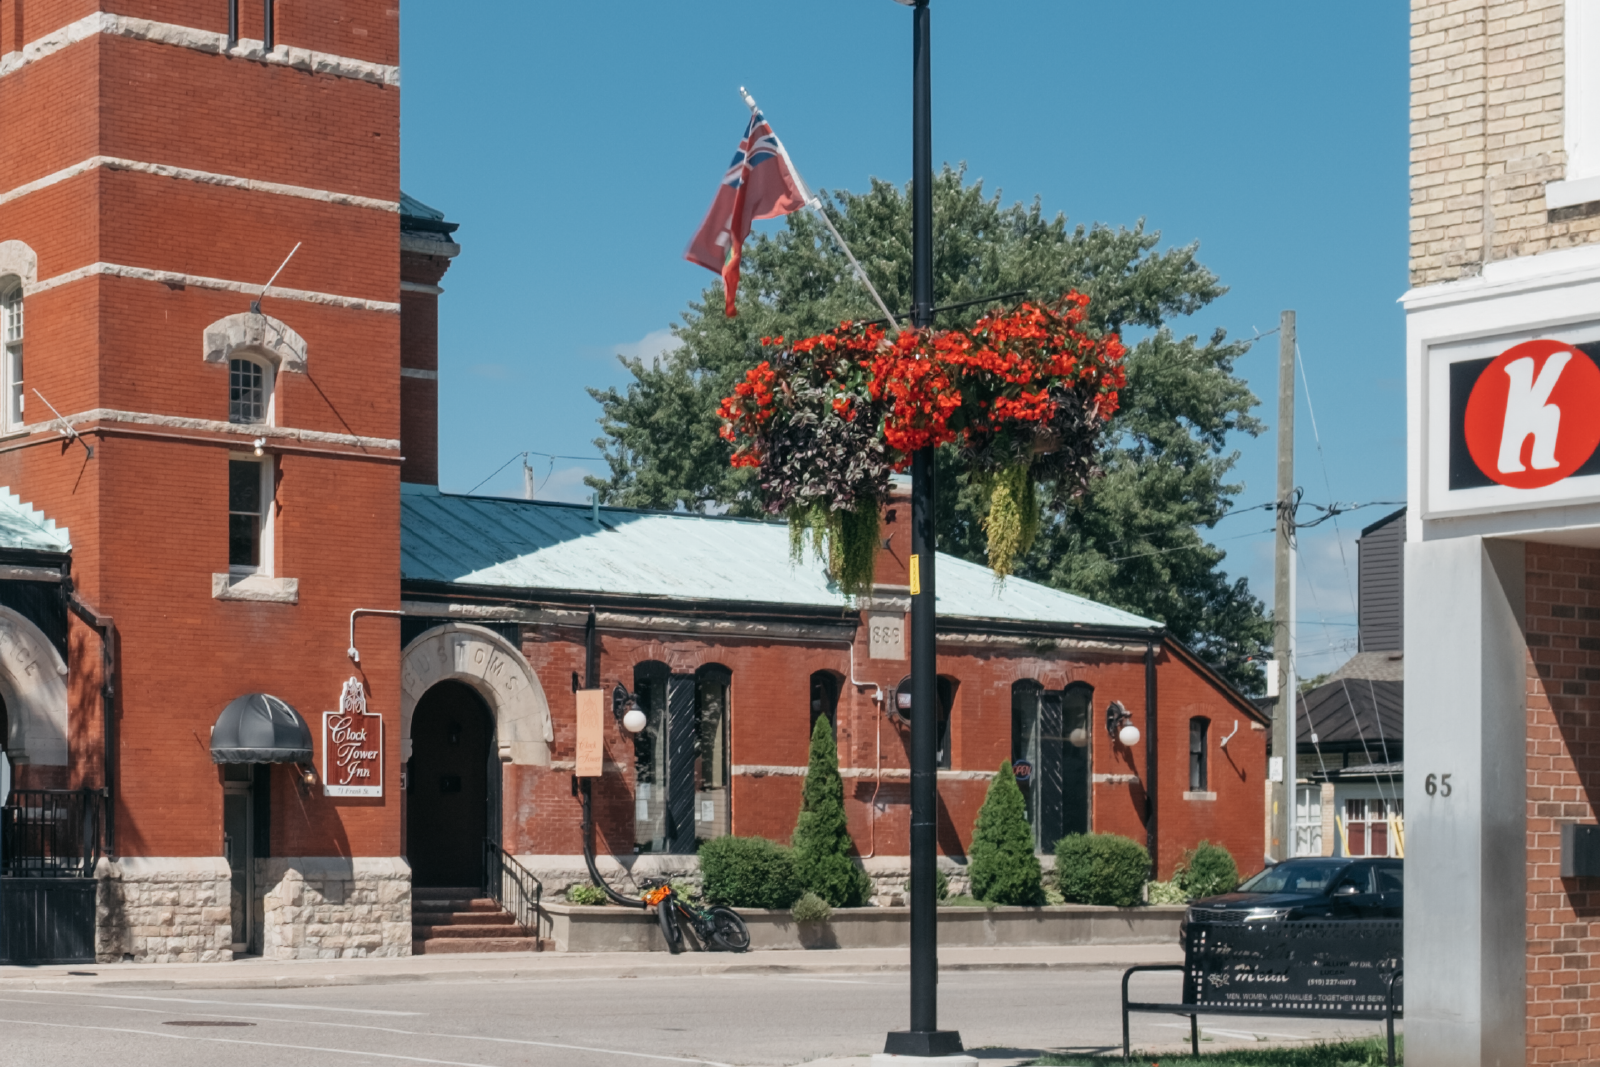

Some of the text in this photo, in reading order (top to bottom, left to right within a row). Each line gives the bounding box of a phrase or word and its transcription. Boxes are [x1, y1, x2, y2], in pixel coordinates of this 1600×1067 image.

[1497, 351, 1573, 474] K
[404, 642, 518, 691] CUSTOMS
[328, 715, 367, 745] Clock
[337, 742, 378, 766] Tower
[339, 761, 370, 784] Inn
[1425, 773, 1452, 798] 65
